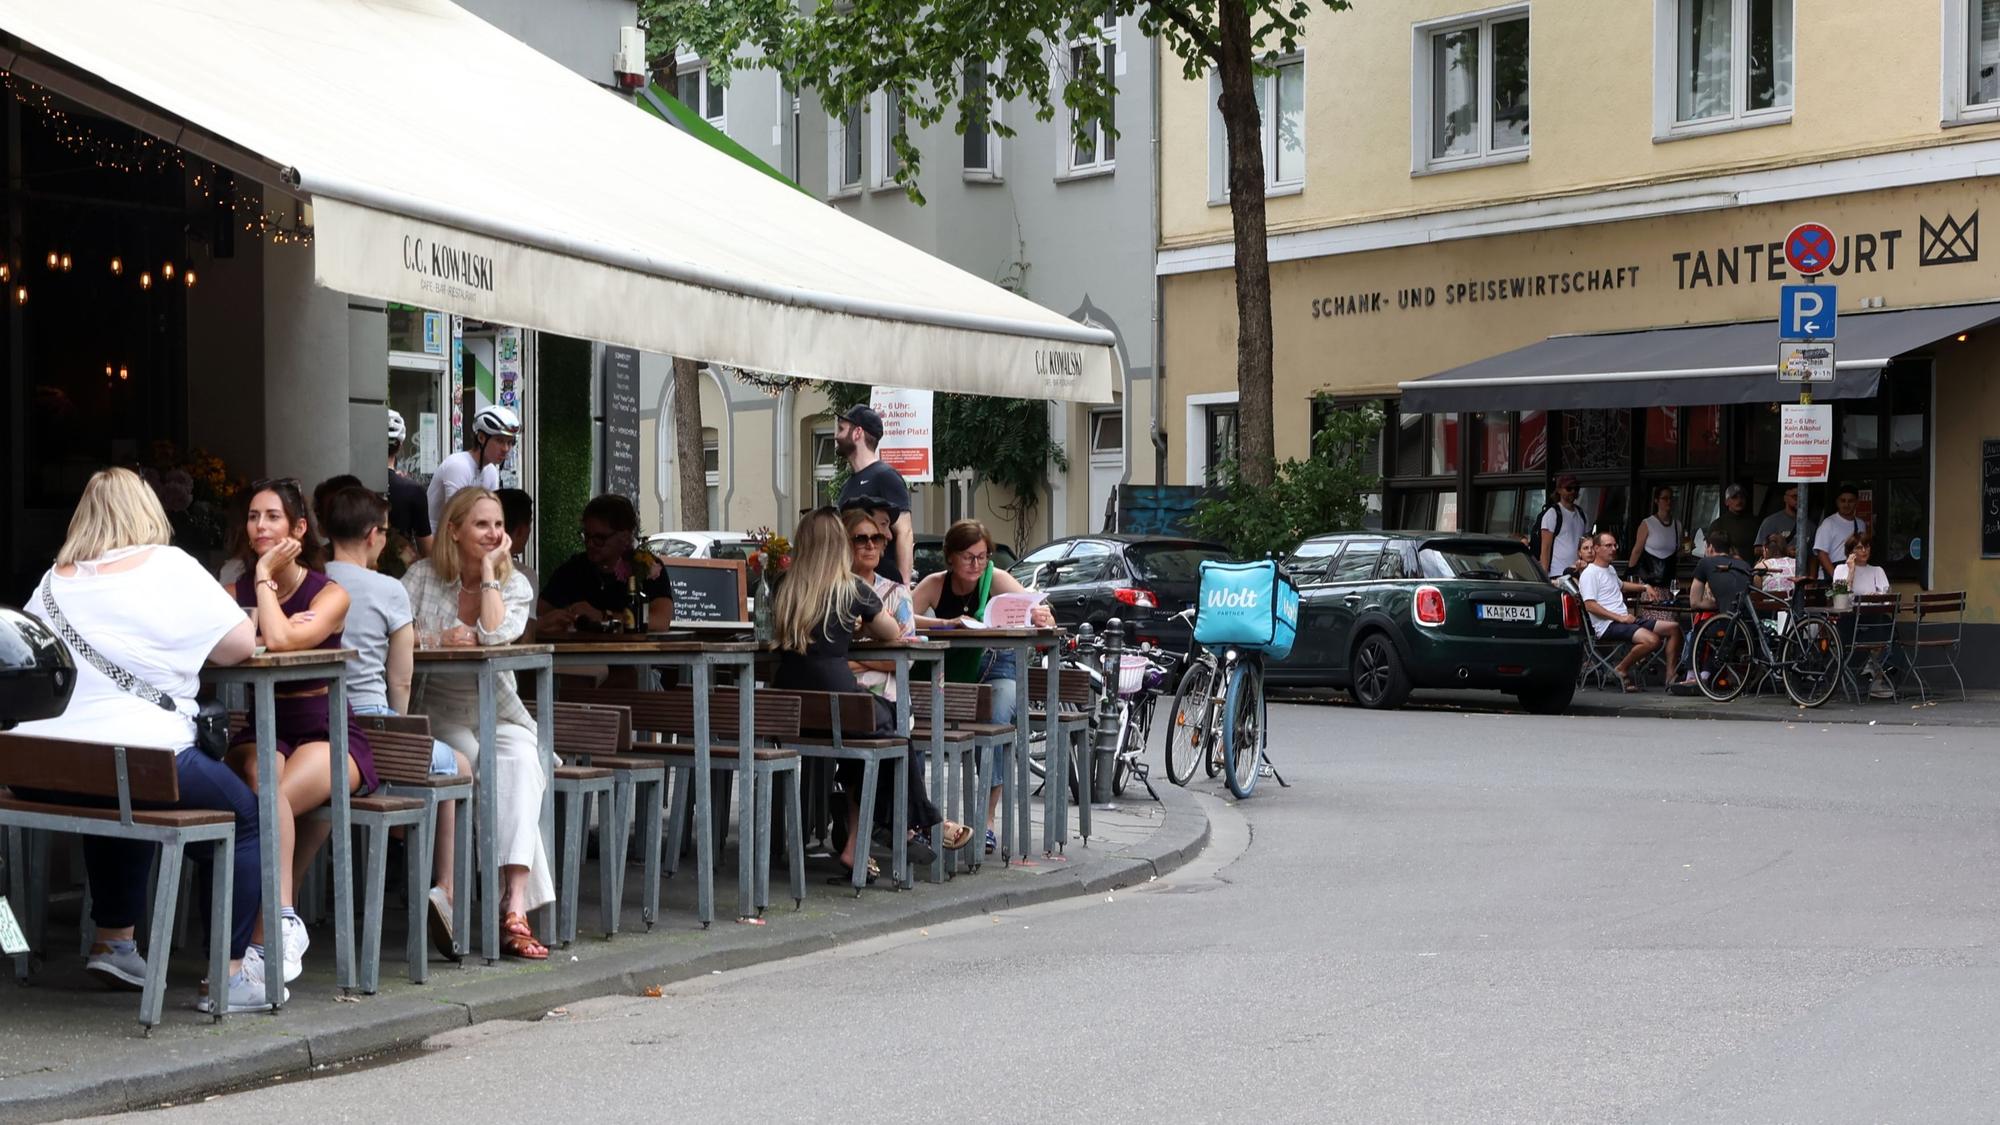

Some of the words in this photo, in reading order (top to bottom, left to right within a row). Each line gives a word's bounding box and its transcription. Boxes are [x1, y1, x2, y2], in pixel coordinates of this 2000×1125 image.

[403, 234, 427, 275] C.C.
[431, 242, 493, 291] KOWALSKI
[1672, 241, 1787, 290] TANTE
[1816, 229, 1902, 278] URT
[1311, 290, 1390, 319] SCHANK-
[1397, 286, 1436, 310] UND
[1445, 265, 1640, 305] SPEISEWIRTSCHAFT
[1792, 291, 1824, 332] P
[873, 402, 882, 410] 22
[888, 410, 917, 418] Alkohol
[907, 427, 929, 435] Platz!
[1207, 587, 1258, 608] Wolt
[1486, 606, 1499, 618] KA
[1504, 607, 1518, 619] KB
[1519, 607, 1532, 619] 41
